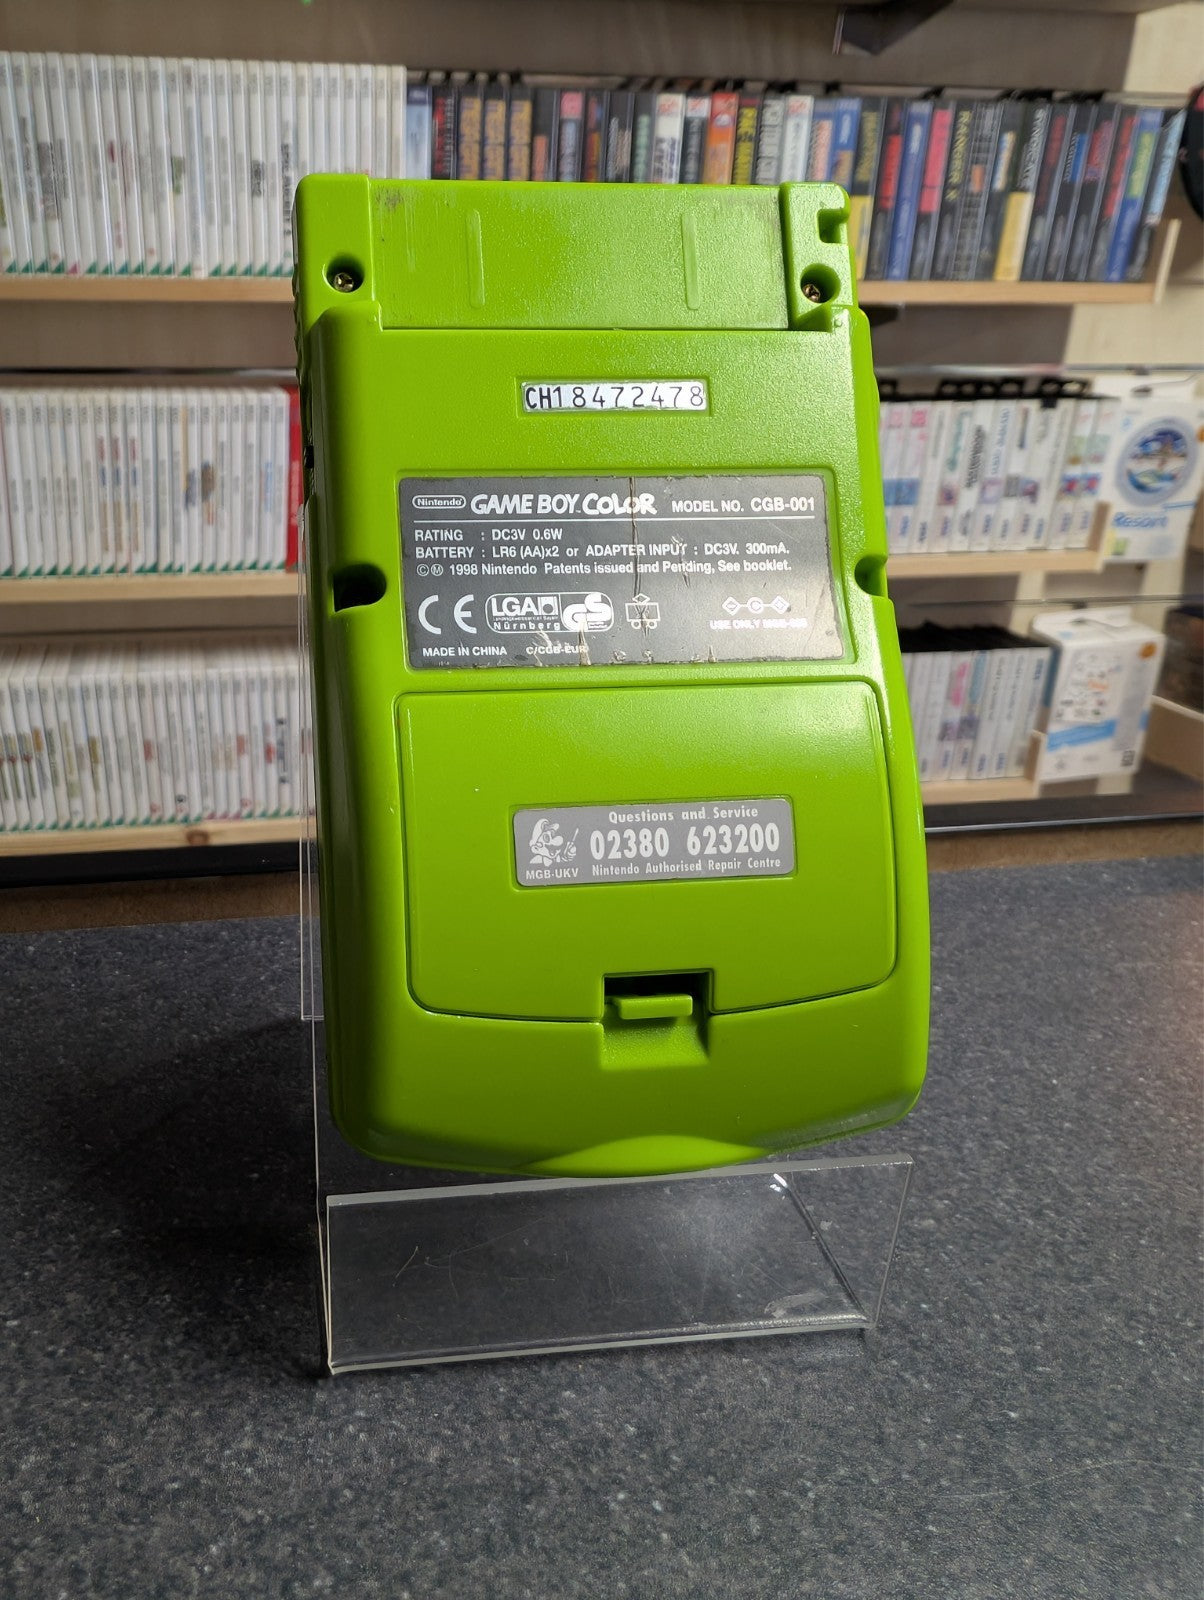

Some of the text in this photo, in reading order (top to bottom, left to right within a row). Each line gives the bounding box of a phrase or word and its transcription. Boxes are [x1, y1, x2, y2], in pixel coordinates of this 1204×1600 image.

[525, 386, 704, 409] CH18472478
[417, 498, 463, 507] Nintendo
[470, 493, 657, 515] GAME BOY COLOR
[672, 497, 815, 513] MODEL NO. CGB-001
[414, 529, 463, 541] RATING
[491, 528, 526, 541] DC3V
[532, 528, 563, 540] 0.6W
[415, 546, 474, 559] BATTERY
[492, 546, 517, 558] LR6
[520, 545, 560, 559] (AA)x2
[566, 547, 579, 557] or
[585, 544, 646, 556] ADAPTER
[648, 543, 687, 556] INPUT
[704, 543, 740, 555] DC3V.
[745, 541, 790, 555] 300mA.
[449, 563, 478, 576] 1998
[481, 562, 537, 576] Nintendo
[544, 562, 591, 574] Patents
[594, 562, 634, 574] issued
[637, 560, 660, 573] and
[662, 560, 715, 575] Pending,
[717, 559, 741, 572] See
[743, 559, 792, 572] booklet.
[491, 597, 538, 616] LGA
[493, 621, 561, 631] Nürnberg
[422, 647, 455, 657] MADE
[458, 646, 470, 656] IN
[472, 646, 508, 656] CHINA
[608, 805, 759, 824] Questions and Service
[590, 822, 780, 860] 02380 623200
[525, 867, 579, 880] MGB-UKV
[592, 856, 781, 876] Nintendo Authorised Repair Centre
